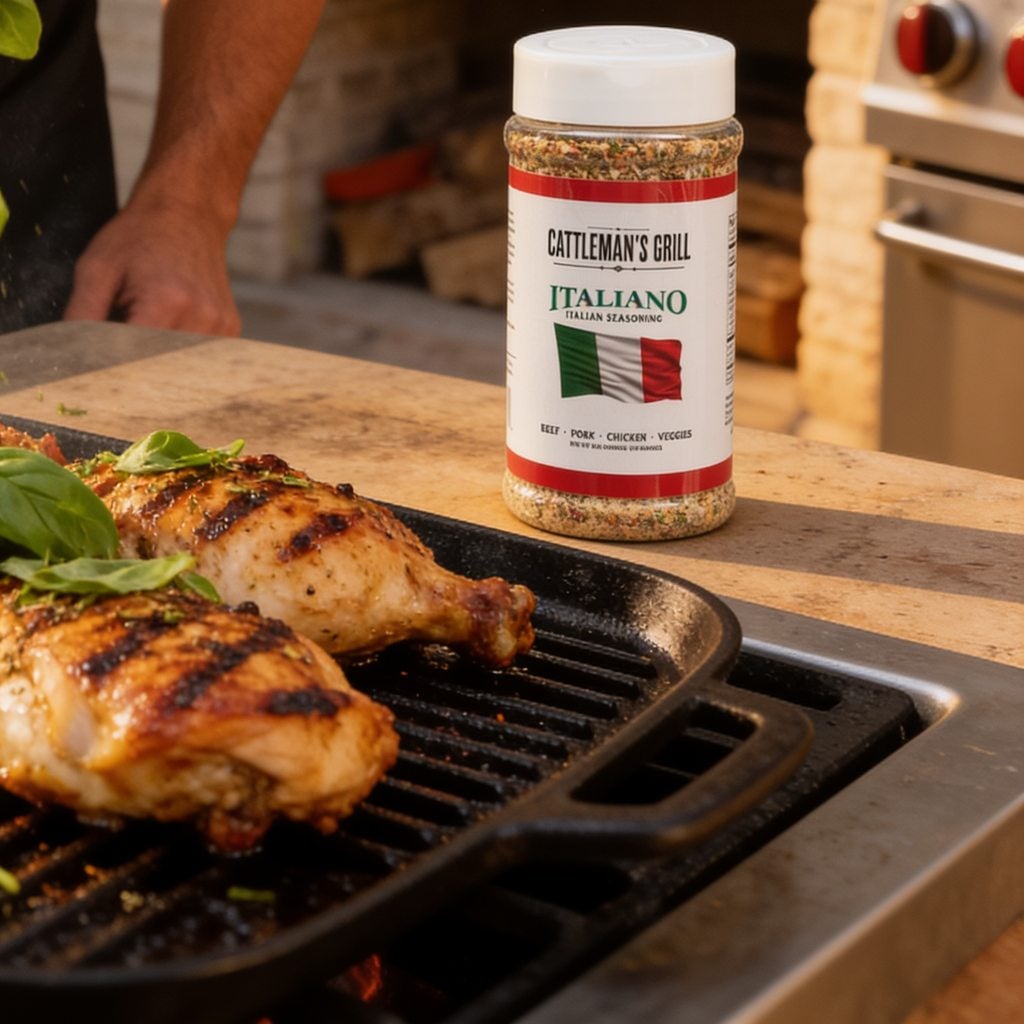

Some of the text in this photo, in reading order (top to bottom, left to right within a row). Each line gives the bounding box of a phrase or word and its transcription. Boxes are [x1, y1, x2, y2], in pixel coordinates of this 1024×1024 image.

[548, 228, 691, 262] CATTLEMAN'S GRILL
[549, 284, 687, 315] ITALIANO
[566, 310, 603, 322] ITALIAN
[570, 429, 595, 439] PORK
[606, 432, 647, 442] CHICKEN
[657, 429, 692, 441] VEGGIES
